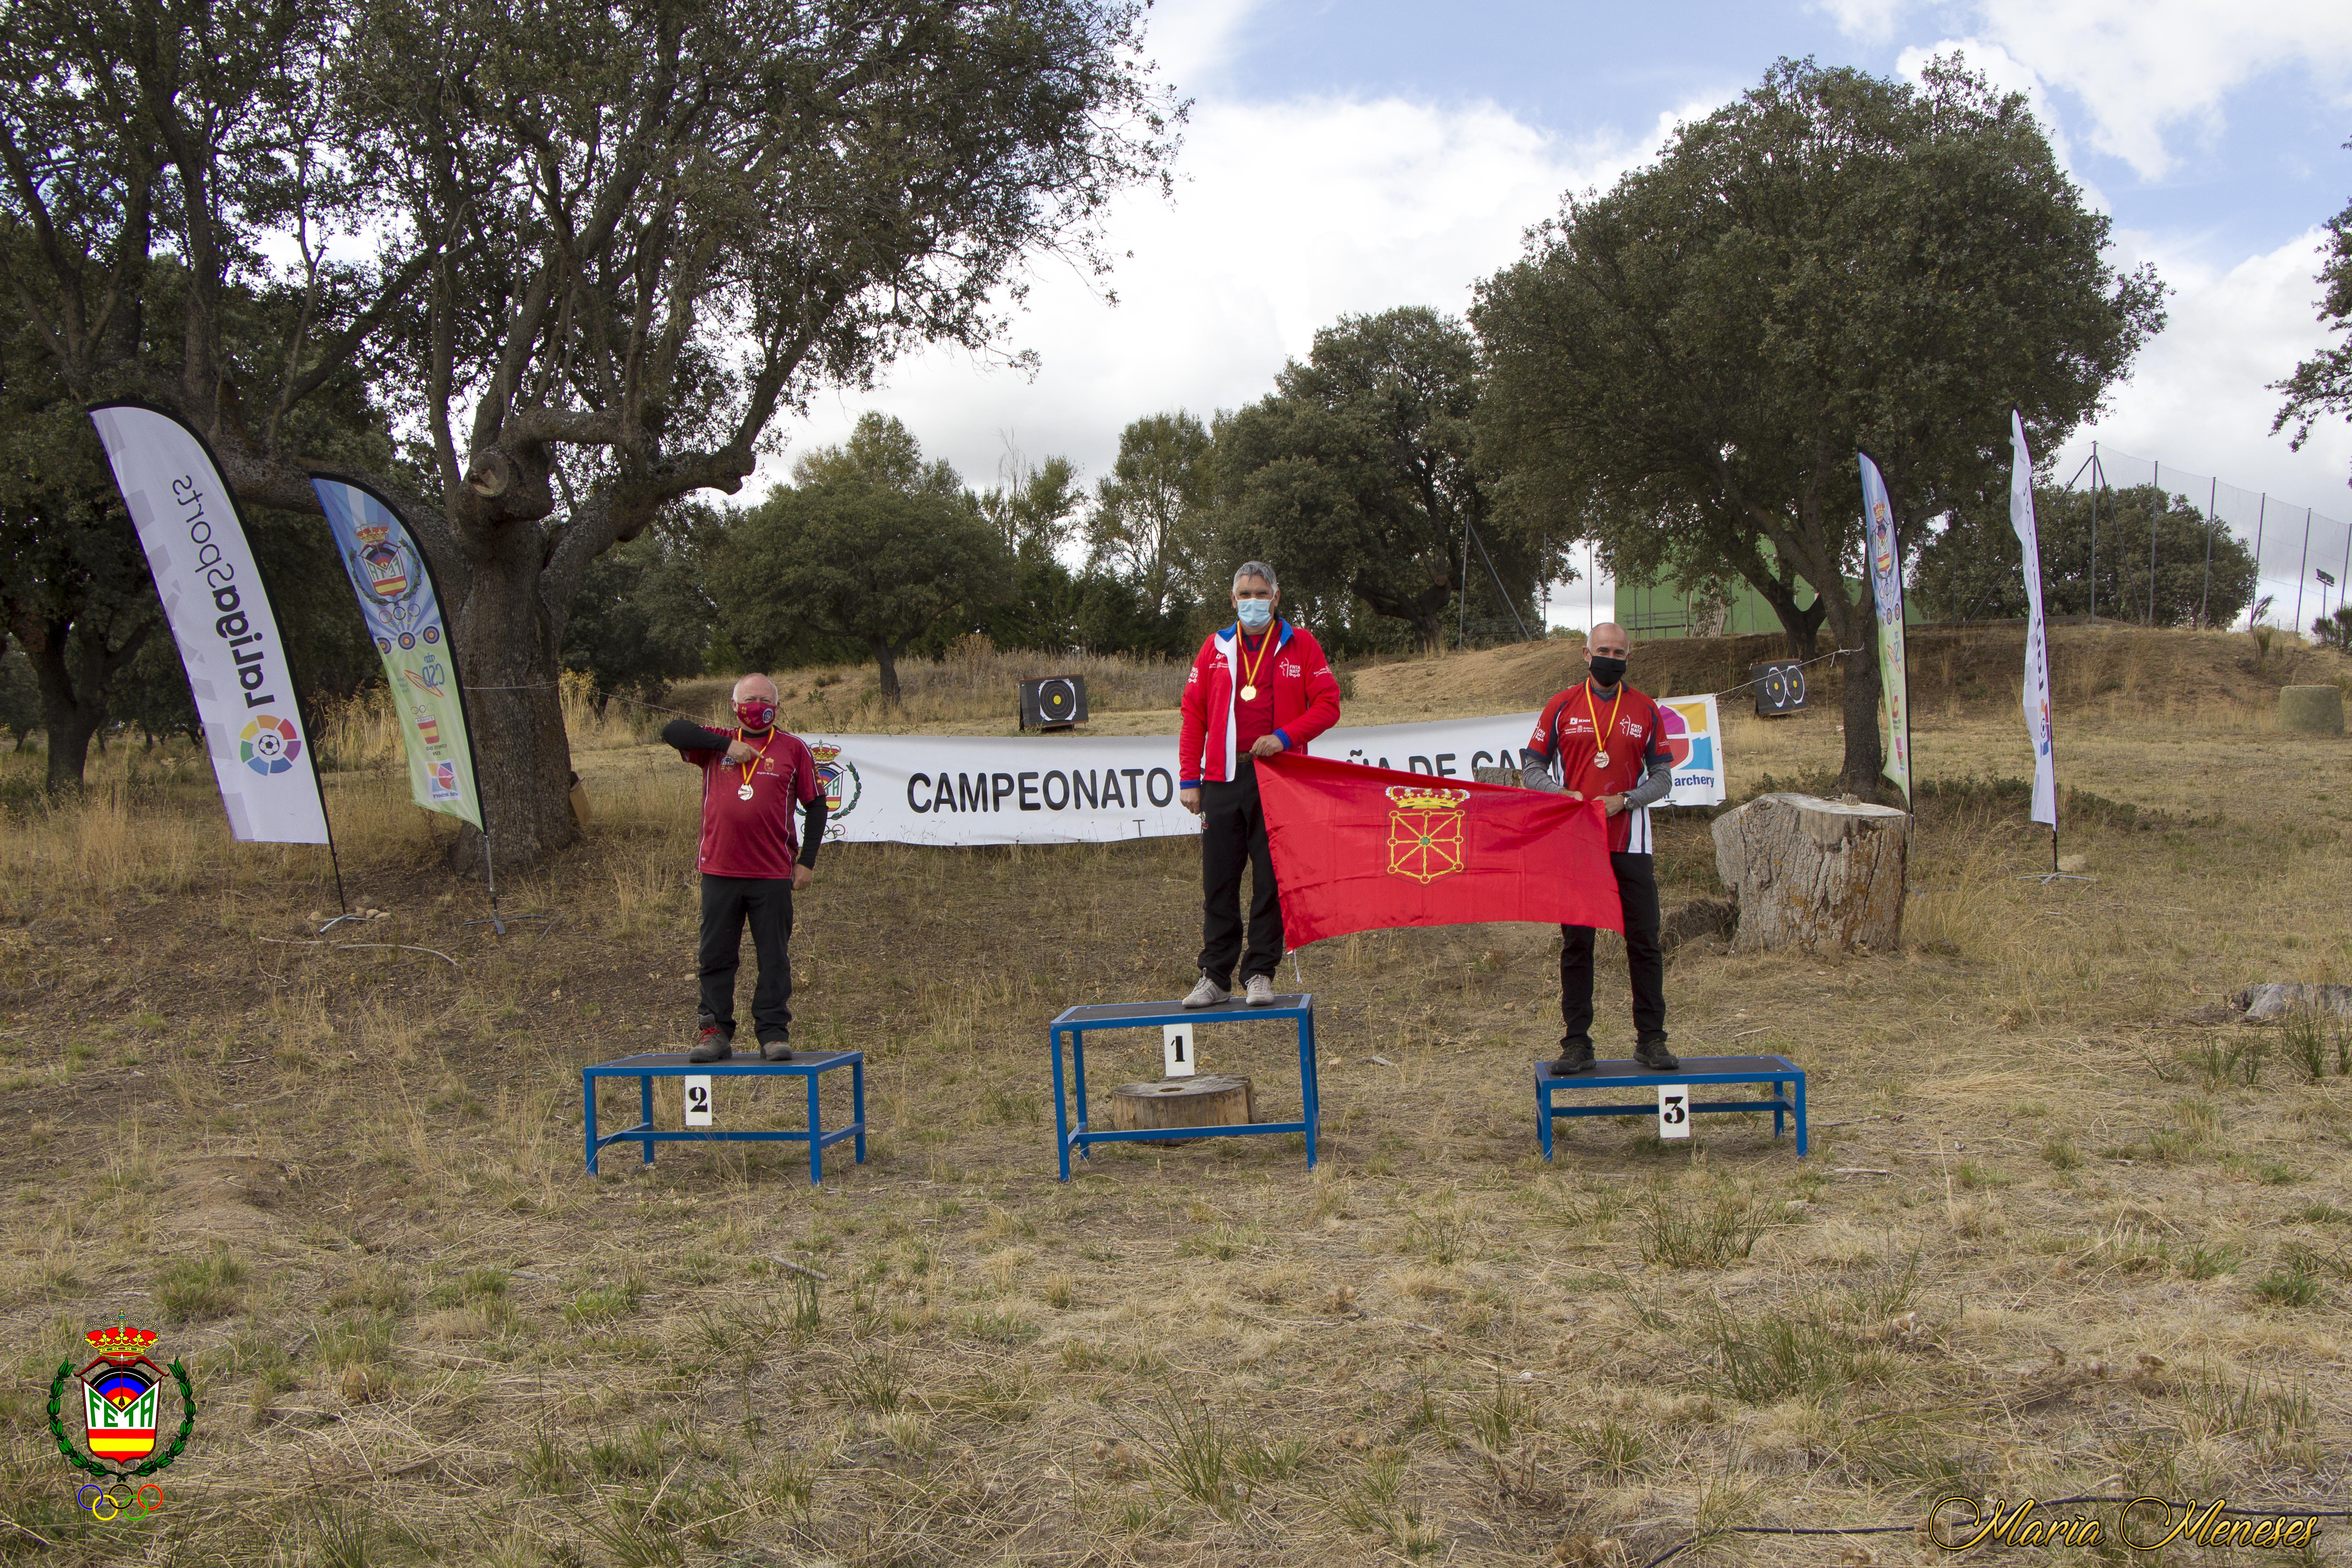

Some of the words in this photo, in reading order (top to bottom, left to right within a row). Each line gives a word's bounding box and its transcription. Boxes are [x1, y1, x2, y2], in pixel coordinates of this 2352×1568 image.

[907, 767, 1174, 813] CAMPEONATO
[1674, 774, 1714, 788] archery
[1171, 1036, 1185, 1062] 1
[689, 1086, 708, 1112] 2
[1664, 1096, 1685, 1124] 3
